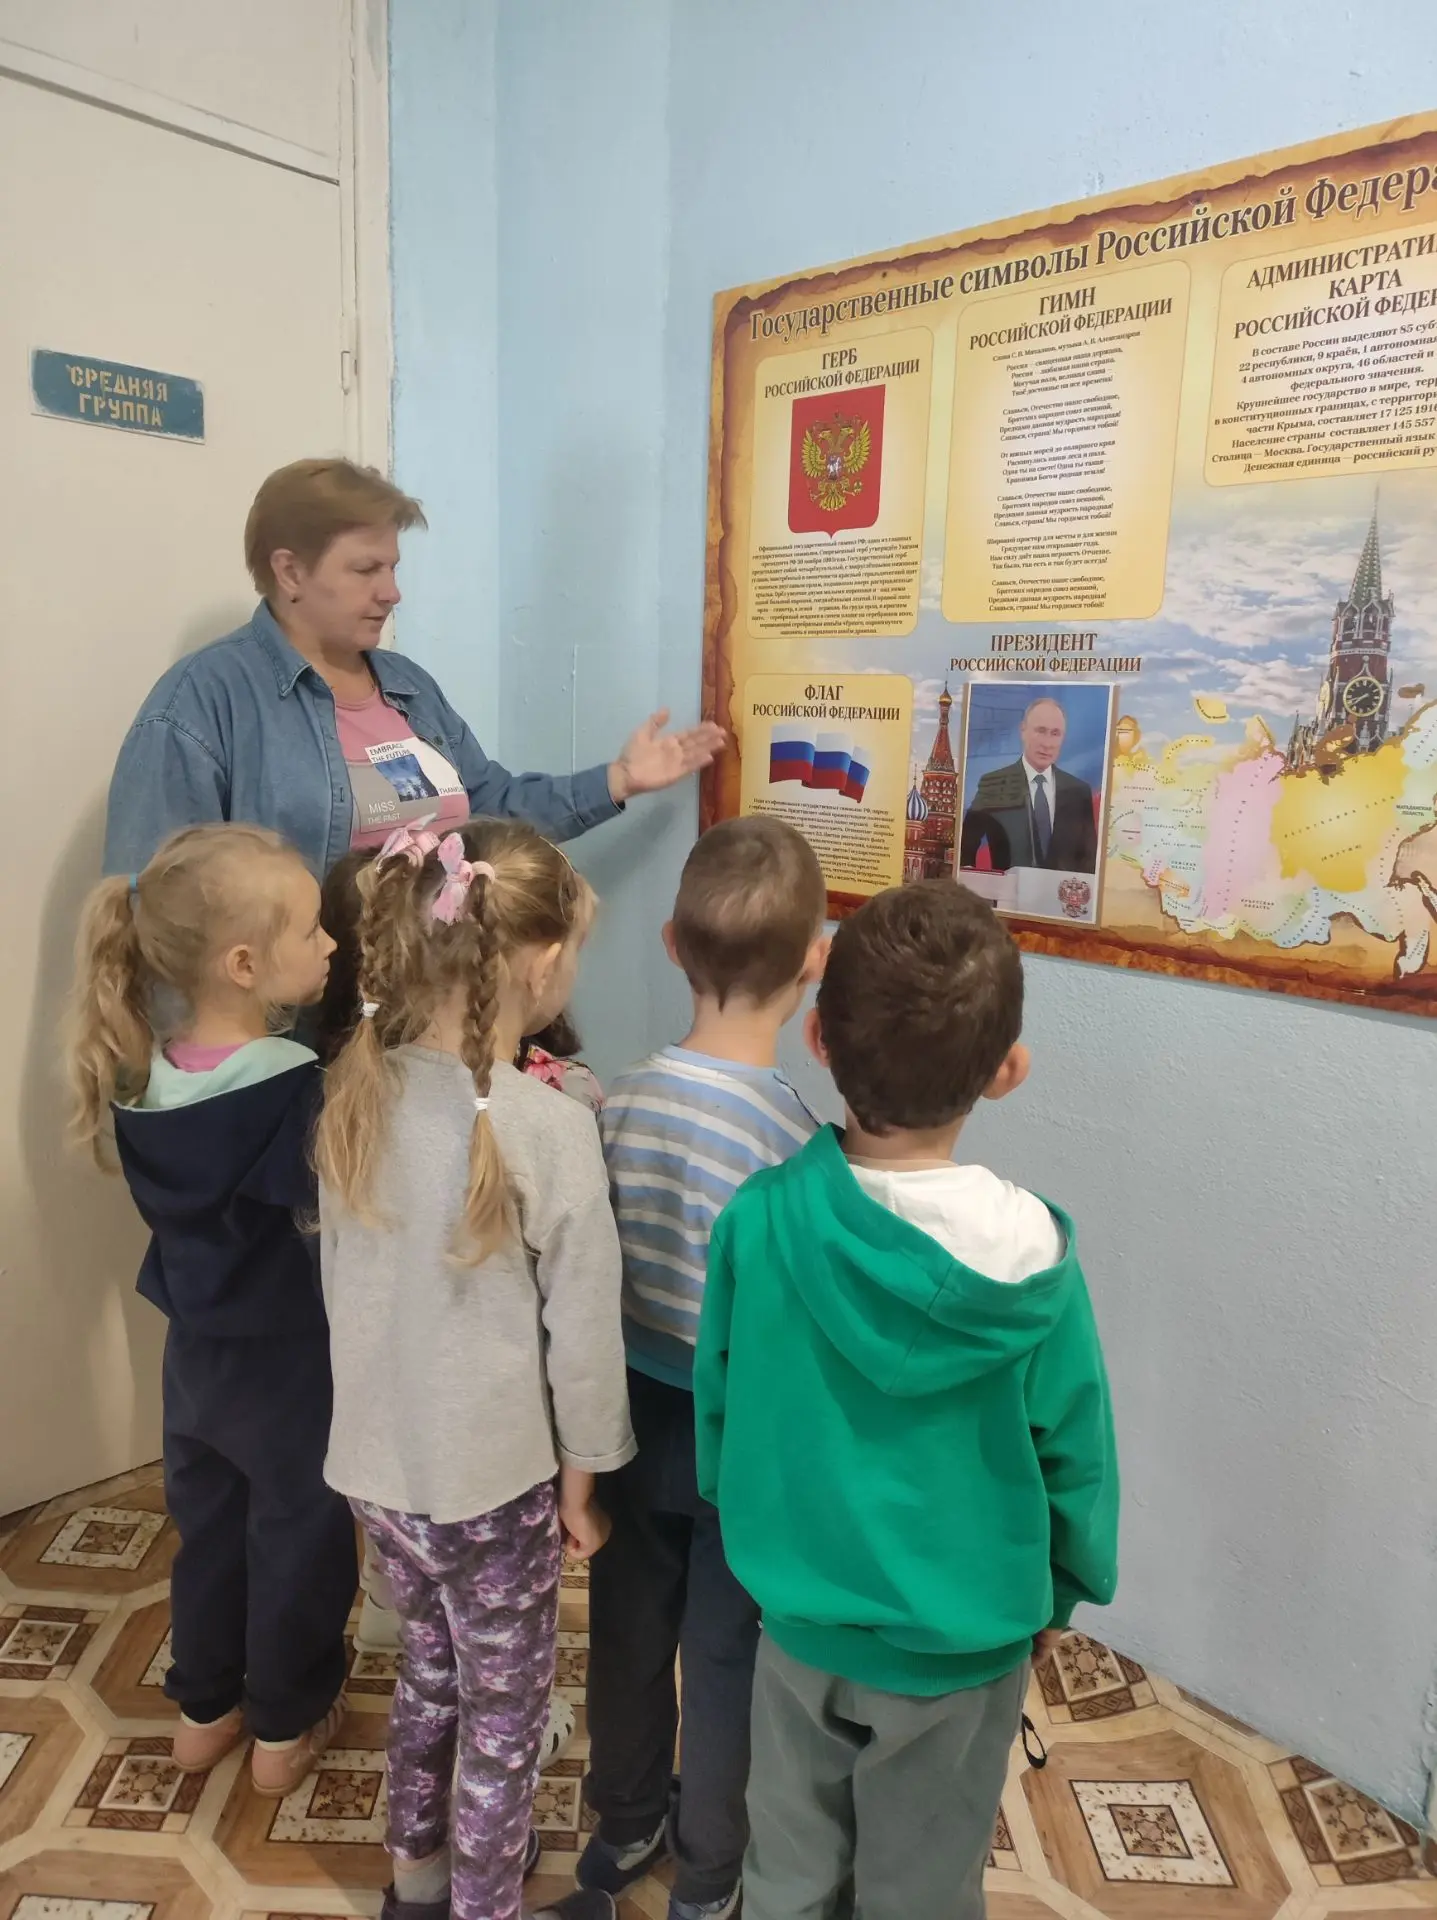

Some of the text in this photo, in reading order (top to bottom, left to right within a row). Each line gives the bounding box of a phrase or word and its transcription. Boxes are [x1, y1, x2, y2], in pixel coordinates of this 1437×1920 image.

[751, 165, 1437, 342] Государственные символы Российской Федер
[1246, 233, 1437, 290] АДМИНИСТРАТИ
[1329, 268, 1404, 299] КАРТА
[1039, 286, 1096, 315] ГИМН
[970, 298, 1173, 350] РОССИЙСКОЙ ФЕДЕРАЦИИ
[1234, 294, 1370, 339] РОССИЙСКОЙ
[1252, 347, 1259, 357] В
[1260, 343, 1300, 356] составе
[1302, 337, 1339, 349] России
[1341, 328, 1397, 343] выделяют
[1399, 323, 1413, 334] 85
[822, 348, 857, 370] ГЕРБ
[1239, 361, 1250, 372] 22
[1252, 354, 1316, 373] республики,
[1317, 350, 1324, 360] 9
[1326, 346, 1361, 360] краёв,
[1363, 343, 1367, 353] 1
[1242, 374, 1247, 384] 4
[1248, 367, 1313, 383] автономных
[1315, 362, 1354, 374] округа,
[1357, 357, 1370, 368] 46
[1372, 349, 1424, 366] областей
[69, 366, 168, 402] СРЕДНЯЯ
[765, 359, 920, 398] РОССИЙСКОЙ ФЕДЕРАЦИИ
[1290, 366, 1424, 392] федерального значения.
[79, 392, 163, 427] ГРУППА
[1236, 395, 1300, 411] Крупнейшее
[1302, 387, 1367, 402] государство
[1378, 382, 1411, 392] мире,
[1221, 407, 1313, 425] конституционных
[1315, 400, 1369, 415] границах,
[1246, 424, 1274, 434] части
[1276, 419, 1316, 432] Крыма,
[1317, 412, 1377, 425] составляет
[1380, 407, 1391, 418] 17
[1394, 405, 1412, 416] 125
[1231, 416, 1434, 448] Население страны составляет 145 557
[1211, 433, 1435, 463] Столица Москва. Государственный язык
[1244, 460, 1294, 472] Денежная
[1296, 456, 1341, 469] единица
[1353, 445, 1420, 464] российский
[991, 633, 1098, 655] ПРЕЗИДЕНТ
[950, 655, 1142, 675] РОССИЙСКОЙ ФЕДЕРАЦИИ
[804, 684, 844, 701] ФЛАГ
[752, 702, 900, 722] РОССИЙСКОЙ ФЕДЕРАЦИИ
[369, 801, 396, 814] MISS
